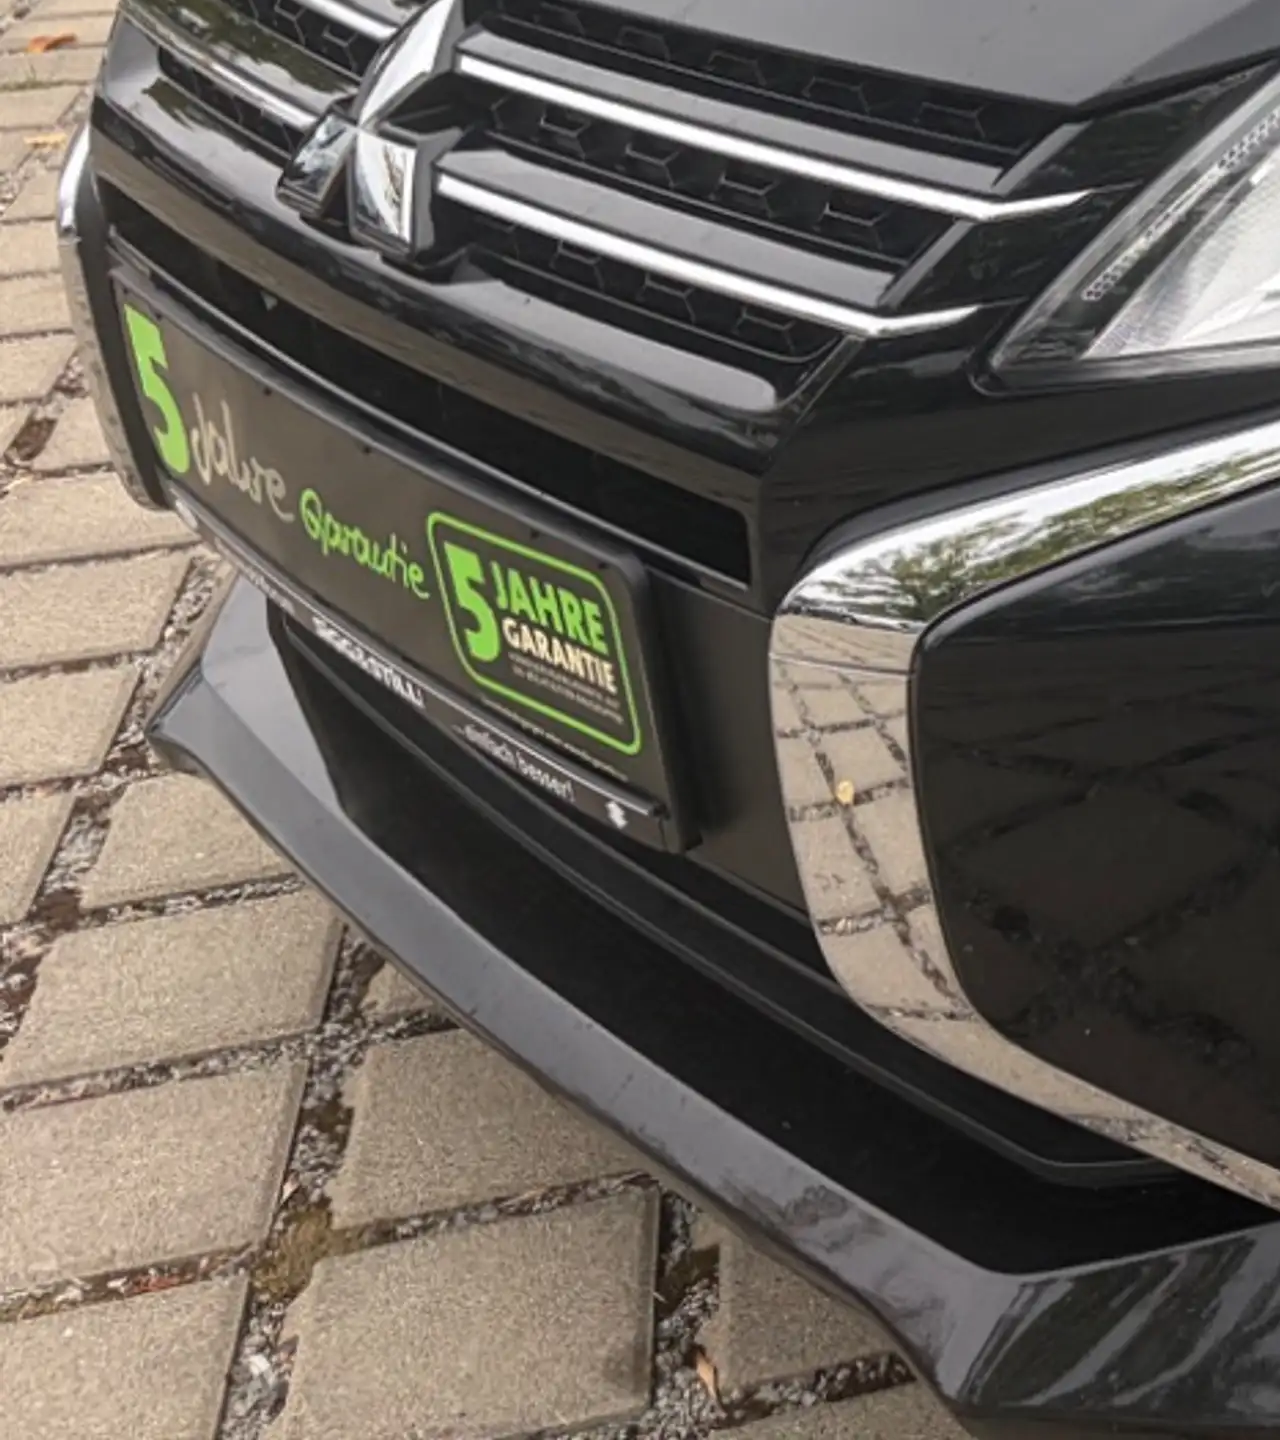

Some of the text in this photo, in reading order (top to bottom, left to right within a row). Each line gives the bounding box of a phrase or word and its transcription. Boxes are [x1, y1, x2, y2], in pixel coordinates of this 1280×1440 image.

[124, 304, 190, 473] 5
[444, 541, 609, 662] 5 JAHRE
[502, 617, 618, 695] GARANTIE
